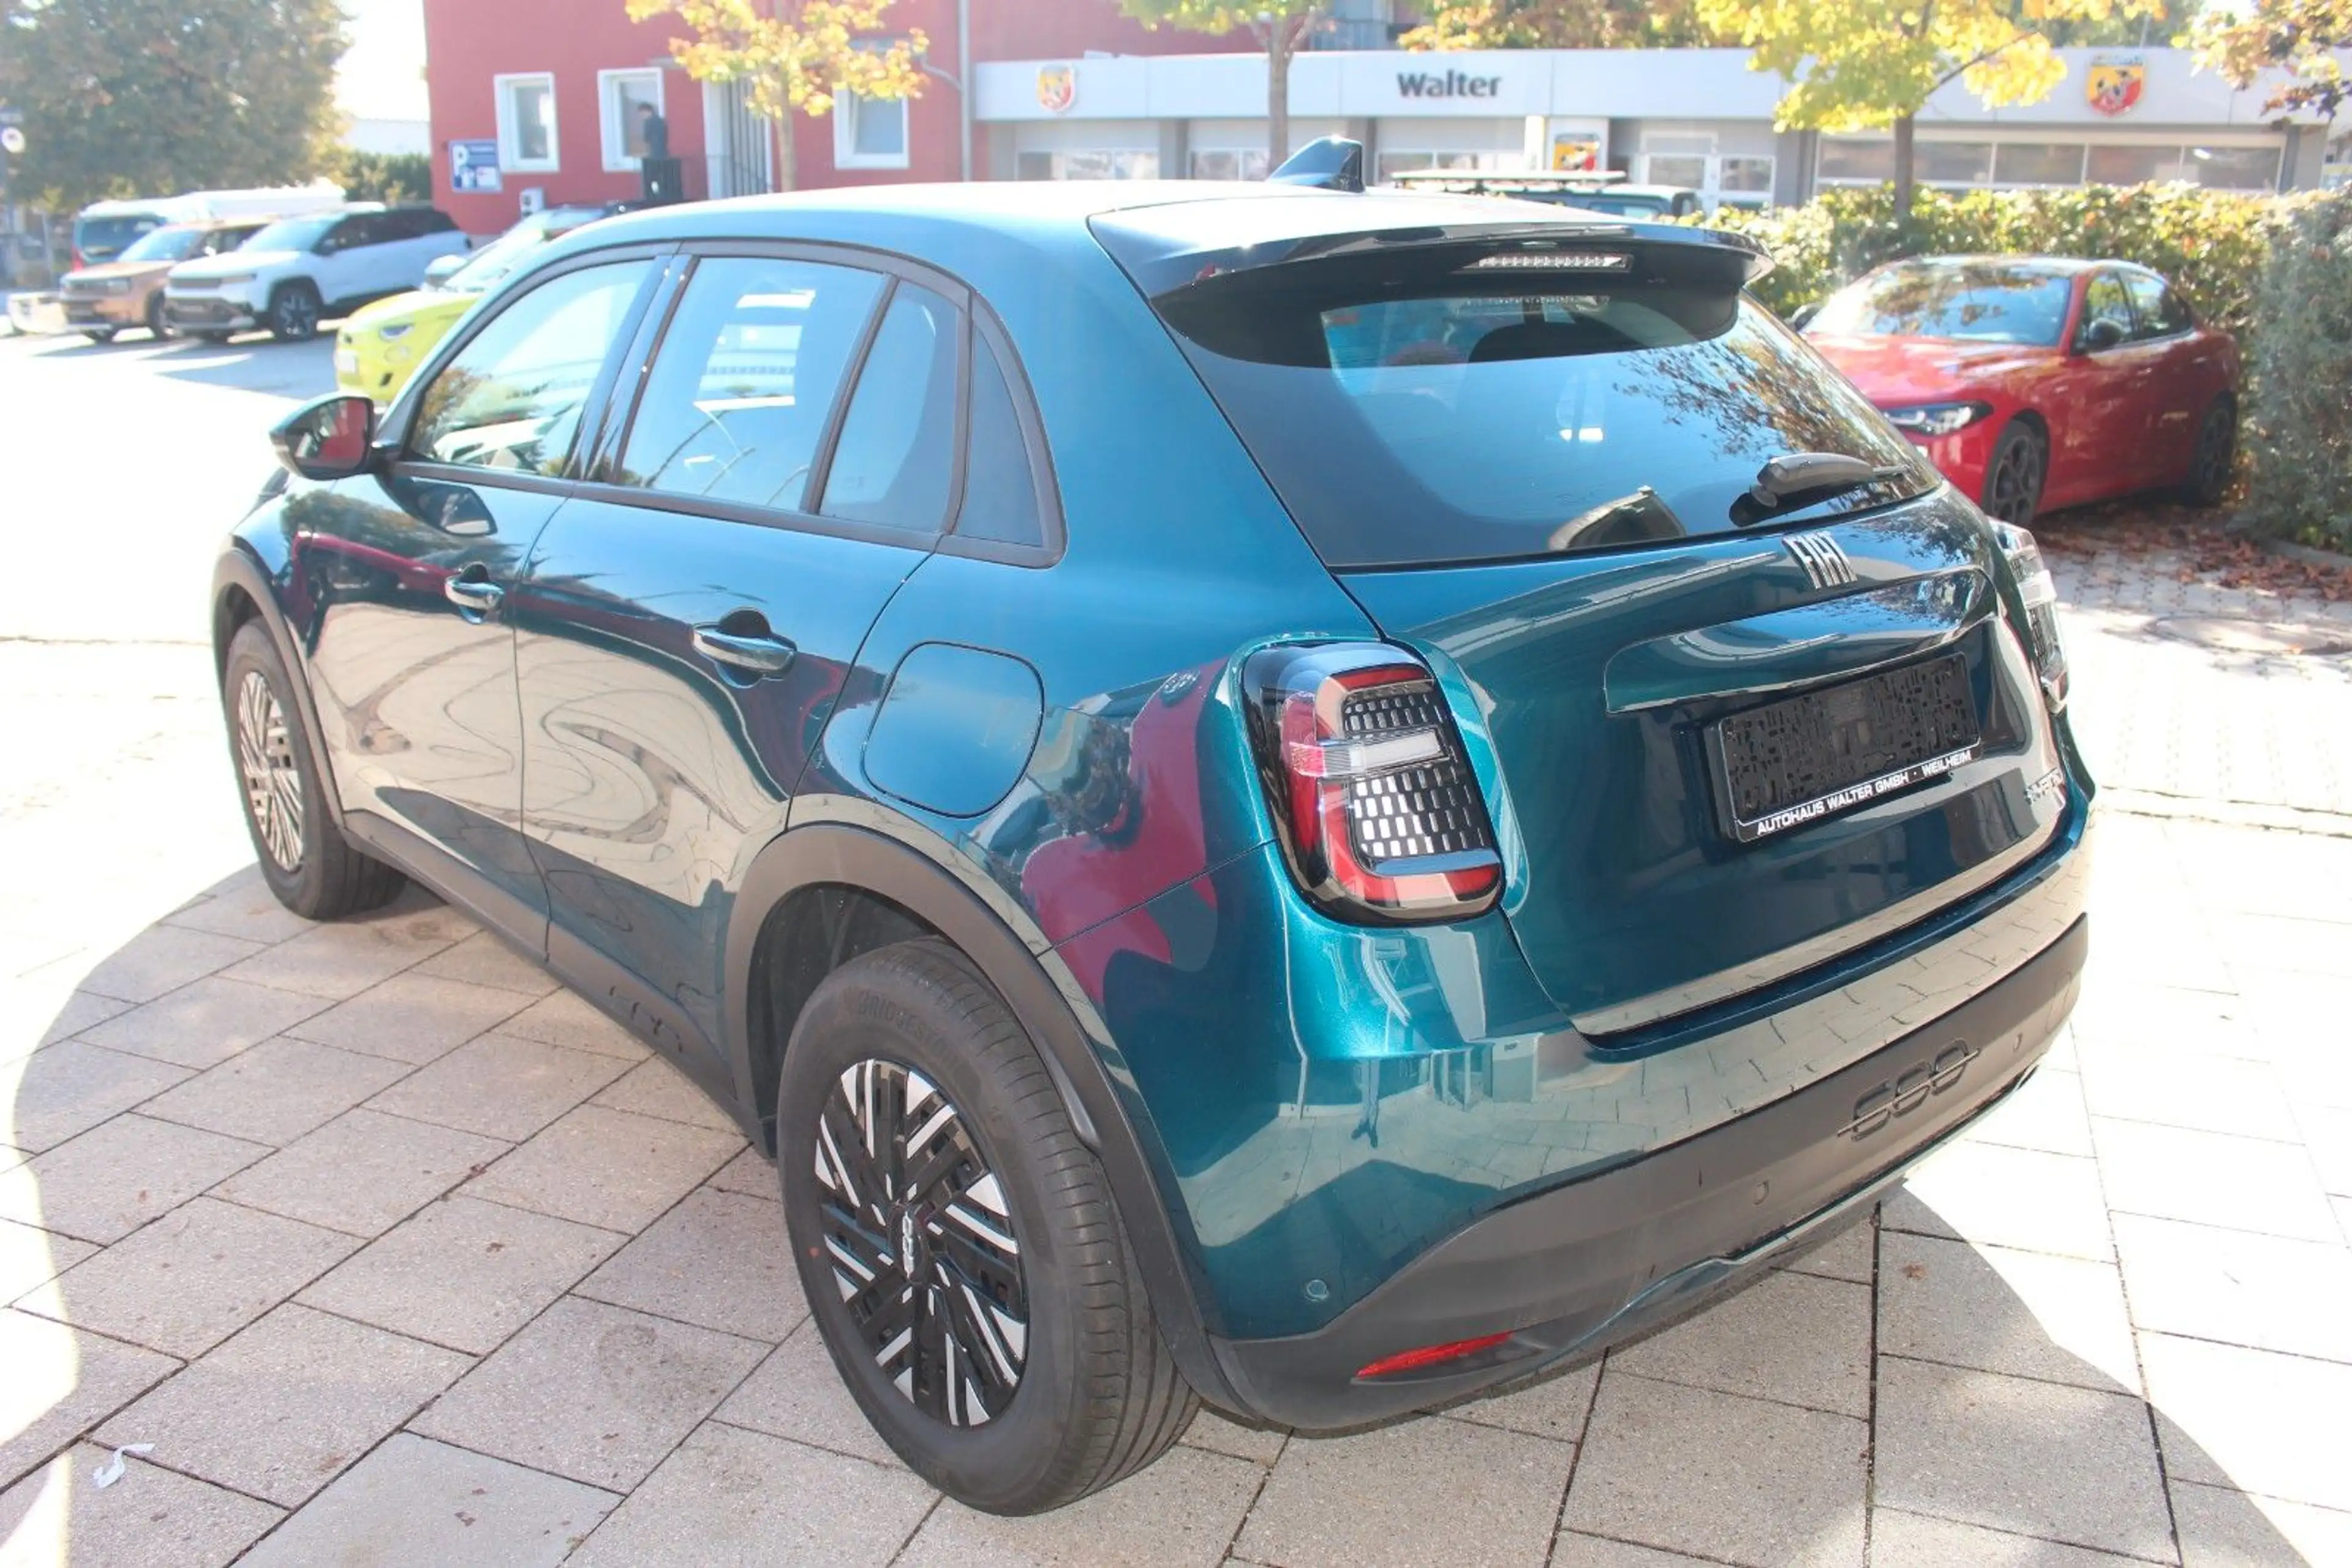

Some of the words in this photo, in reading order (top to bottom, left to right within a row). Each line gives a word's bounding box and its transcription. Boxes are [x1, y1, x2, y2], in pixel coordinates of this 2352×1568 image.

[1397, 69, 1502, 98] Walter
[1781, 529, 1858, 589] FIAT
[1757, 800, 1825, 836] AUTOHAUS
[1826, 783, 1874, 811] WALTER
[1875, 771, 1910, 794] GMBH
[1921, 749, 1972, 778] WEILHEIM
[1839, 1038, 1981, 1141] 600
